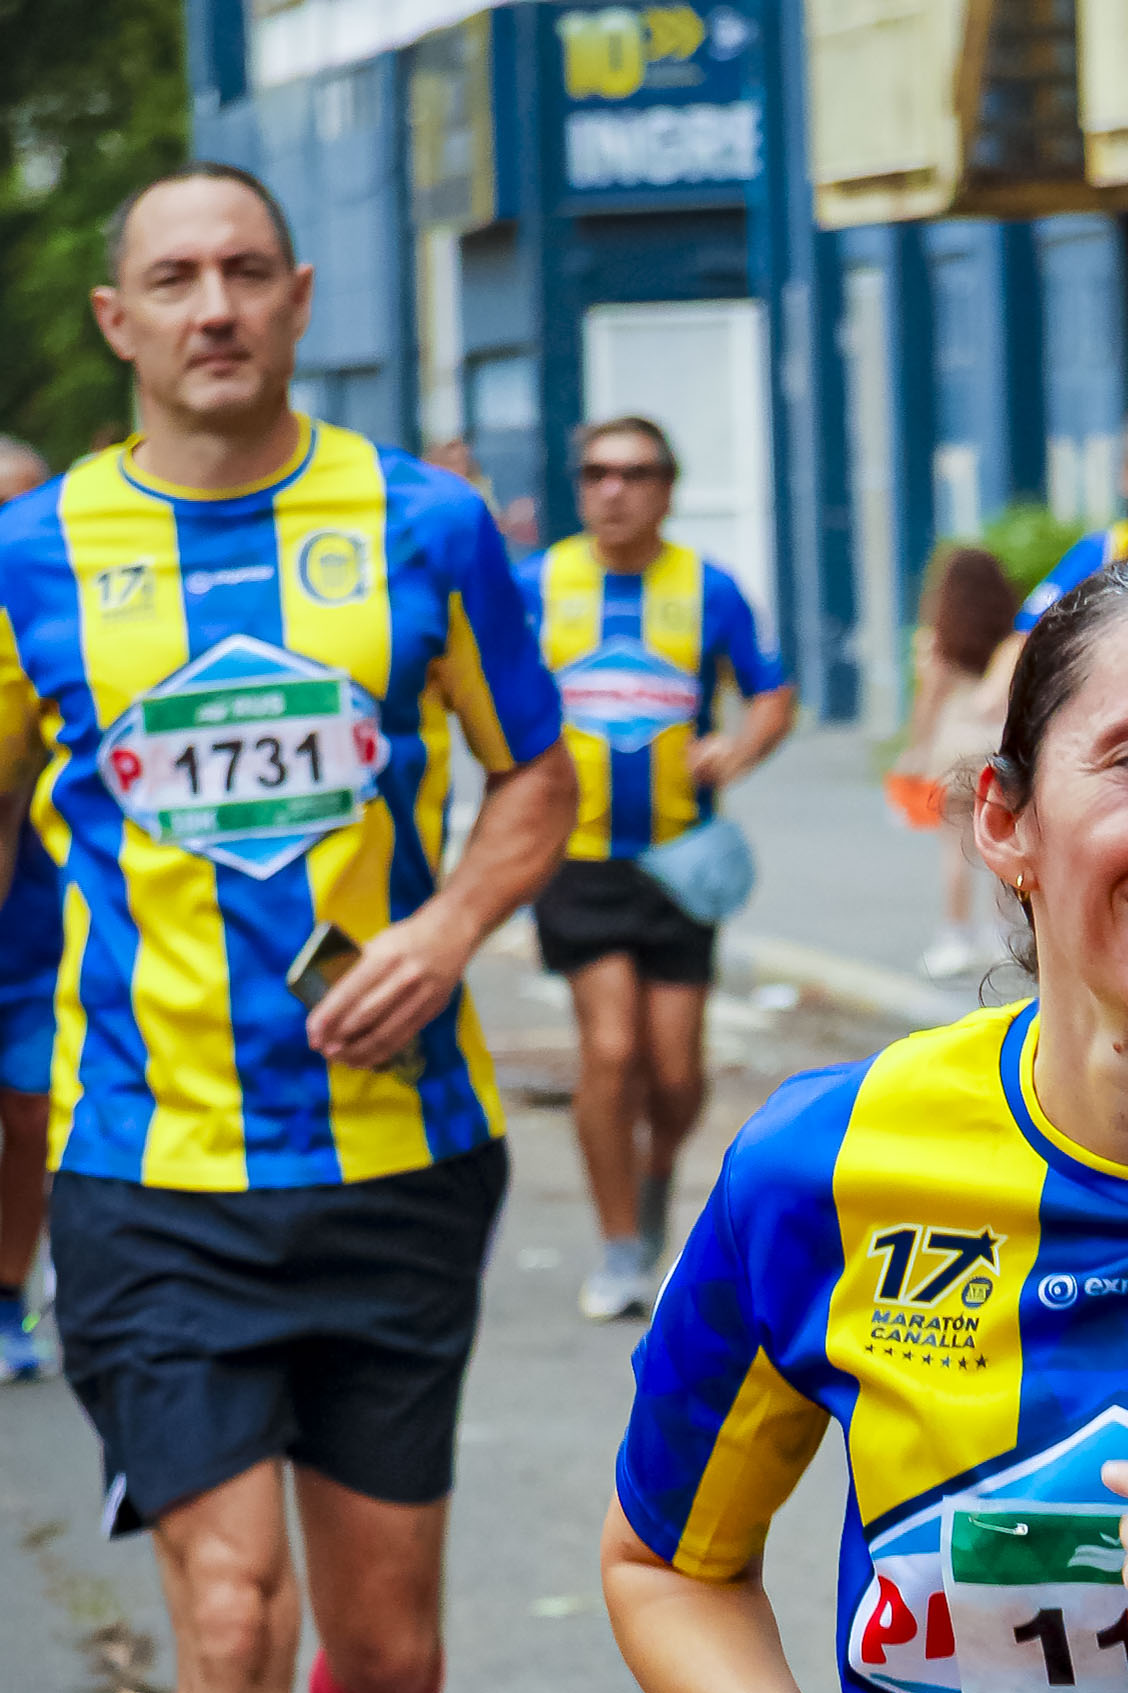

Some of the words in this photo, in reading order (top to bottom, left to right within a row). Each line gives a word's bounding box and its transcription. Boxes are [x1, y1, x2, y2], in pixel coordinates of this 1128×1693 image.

[175, 731, 320, 794] 1731
[868, 1224, 1006, 1308] 17
[871, 1327, 975, 1349] CANALLA
[872, 1309, 979, 1332] MARATÓN
